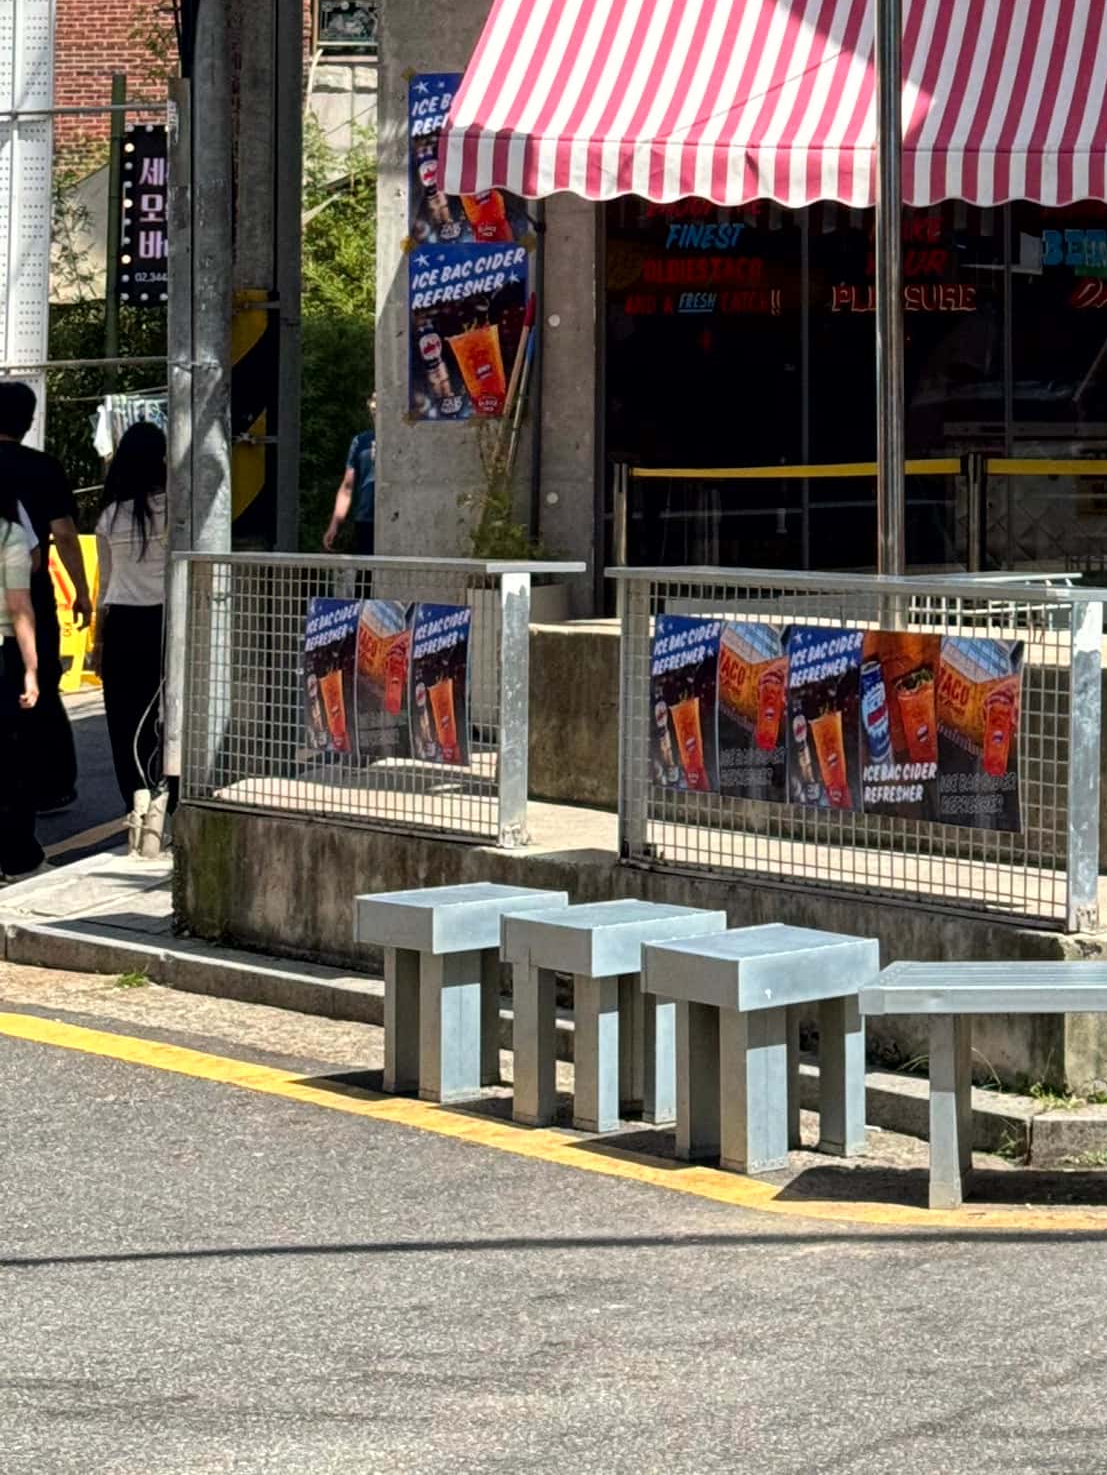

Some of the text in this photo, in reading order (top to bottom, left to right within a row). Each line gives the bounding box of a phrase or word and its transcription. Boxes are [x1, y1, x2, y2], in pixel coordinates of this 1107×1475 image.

[411, 96, 439, 117] ICE
[664, 222, 746, 251] FINEST
[412, 247, 526, 290] ICE BAC CIDER
[411, 272, 505, 310] REFRESHER
[677, 291, 717, 310] FRESH
[831, 283, 976, 313] PLSURE
[654, 622, 721, 655] ICE BAC CIDER
[790, 631, 864, 668] ICE BAC CIDER
[652, 645, 707, 676] REFRESHER
[789, 656, 849, 689] REFRESHER
[863, 761, 938, 782] ICE BAC CIDER
[863, 783, 925, 804] REFRESHER
